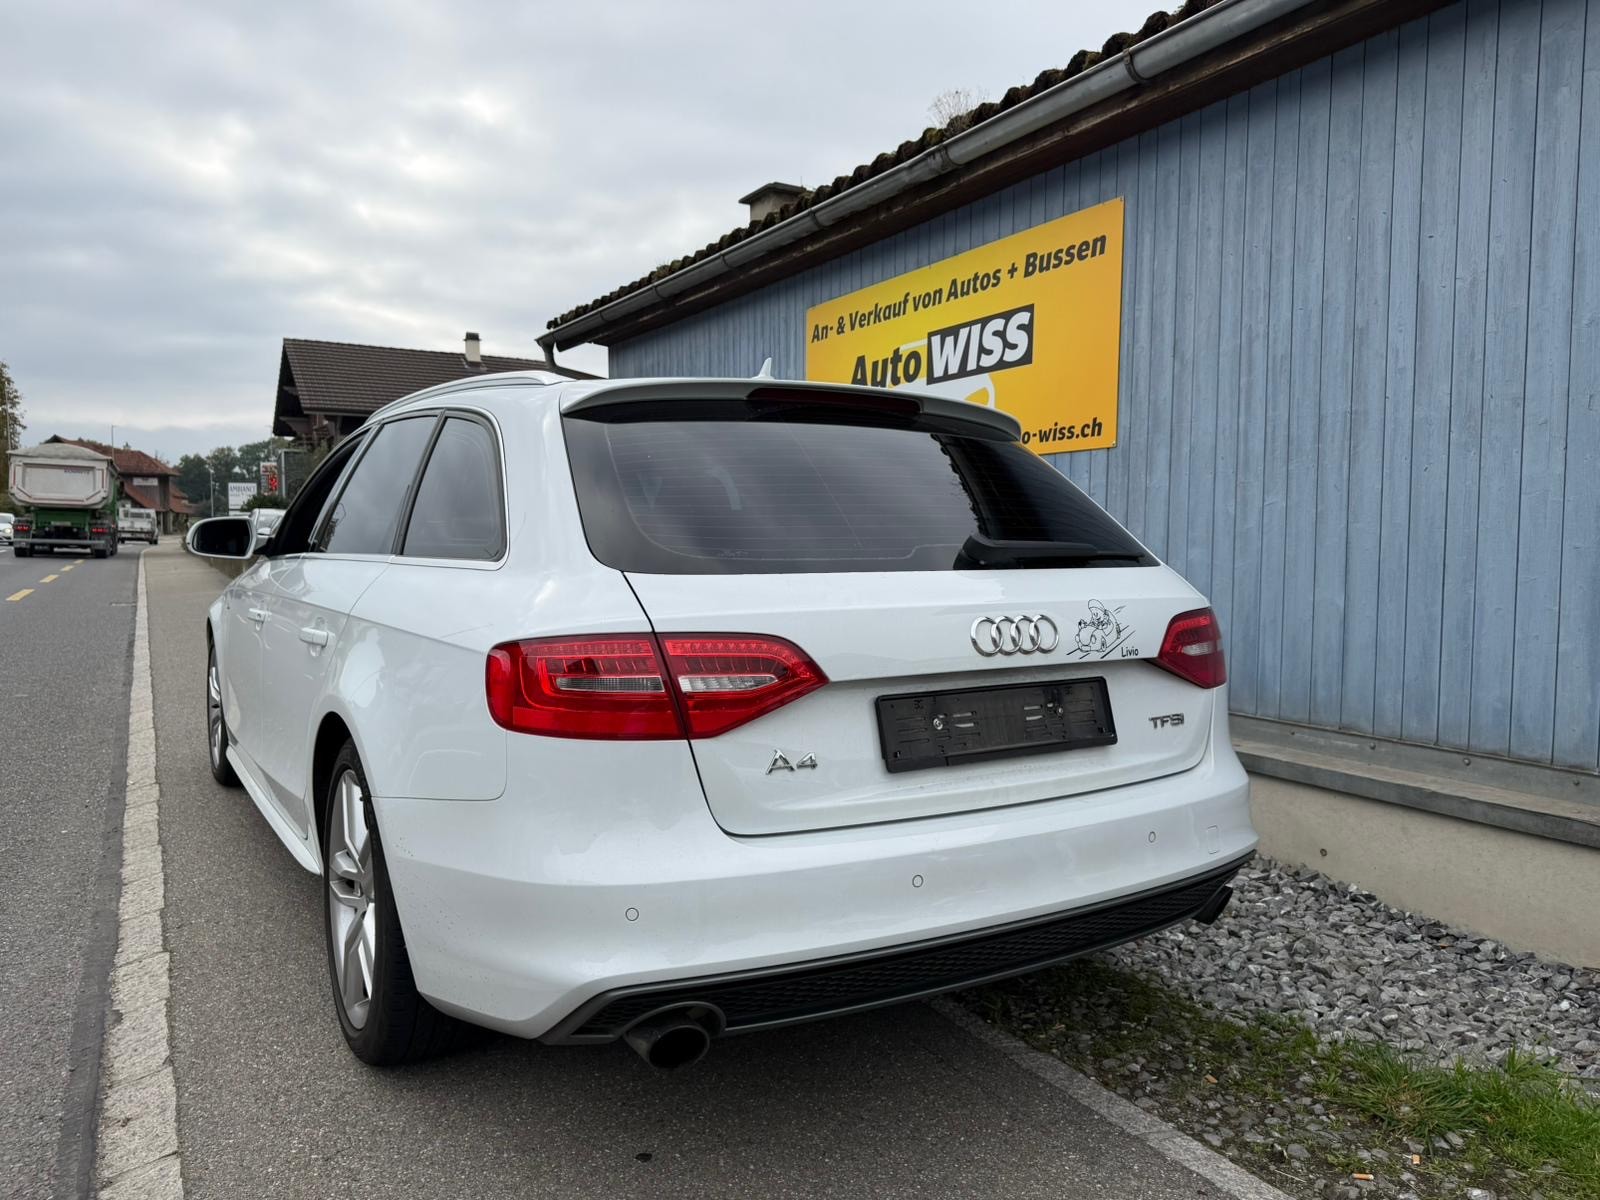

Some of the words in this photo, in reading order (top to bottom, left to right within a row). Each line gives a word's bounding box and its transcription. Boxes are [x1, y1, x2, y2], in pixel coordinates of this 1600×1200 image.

[811, 323, 834, 343] An-
[836, 315, 846, 335] &
[848, 291, 911, 331] Verkauf
[912, 287, 943, 312] von
[945, 268, 1002, 302] Autos
[1007, 262, 1018, 279] +
[1023, 234, 1107, 278] Bussen
[851, 346, 922, 388] Auto
[930, 311, 1032, 378] WISS
[1021, 416, 1103, 444] o-wiss.ch
[1121, 645, 1139, 658] Livio
[1148, 712, 1185, 729] TFSI
[765, 749, 818, 775] A4
